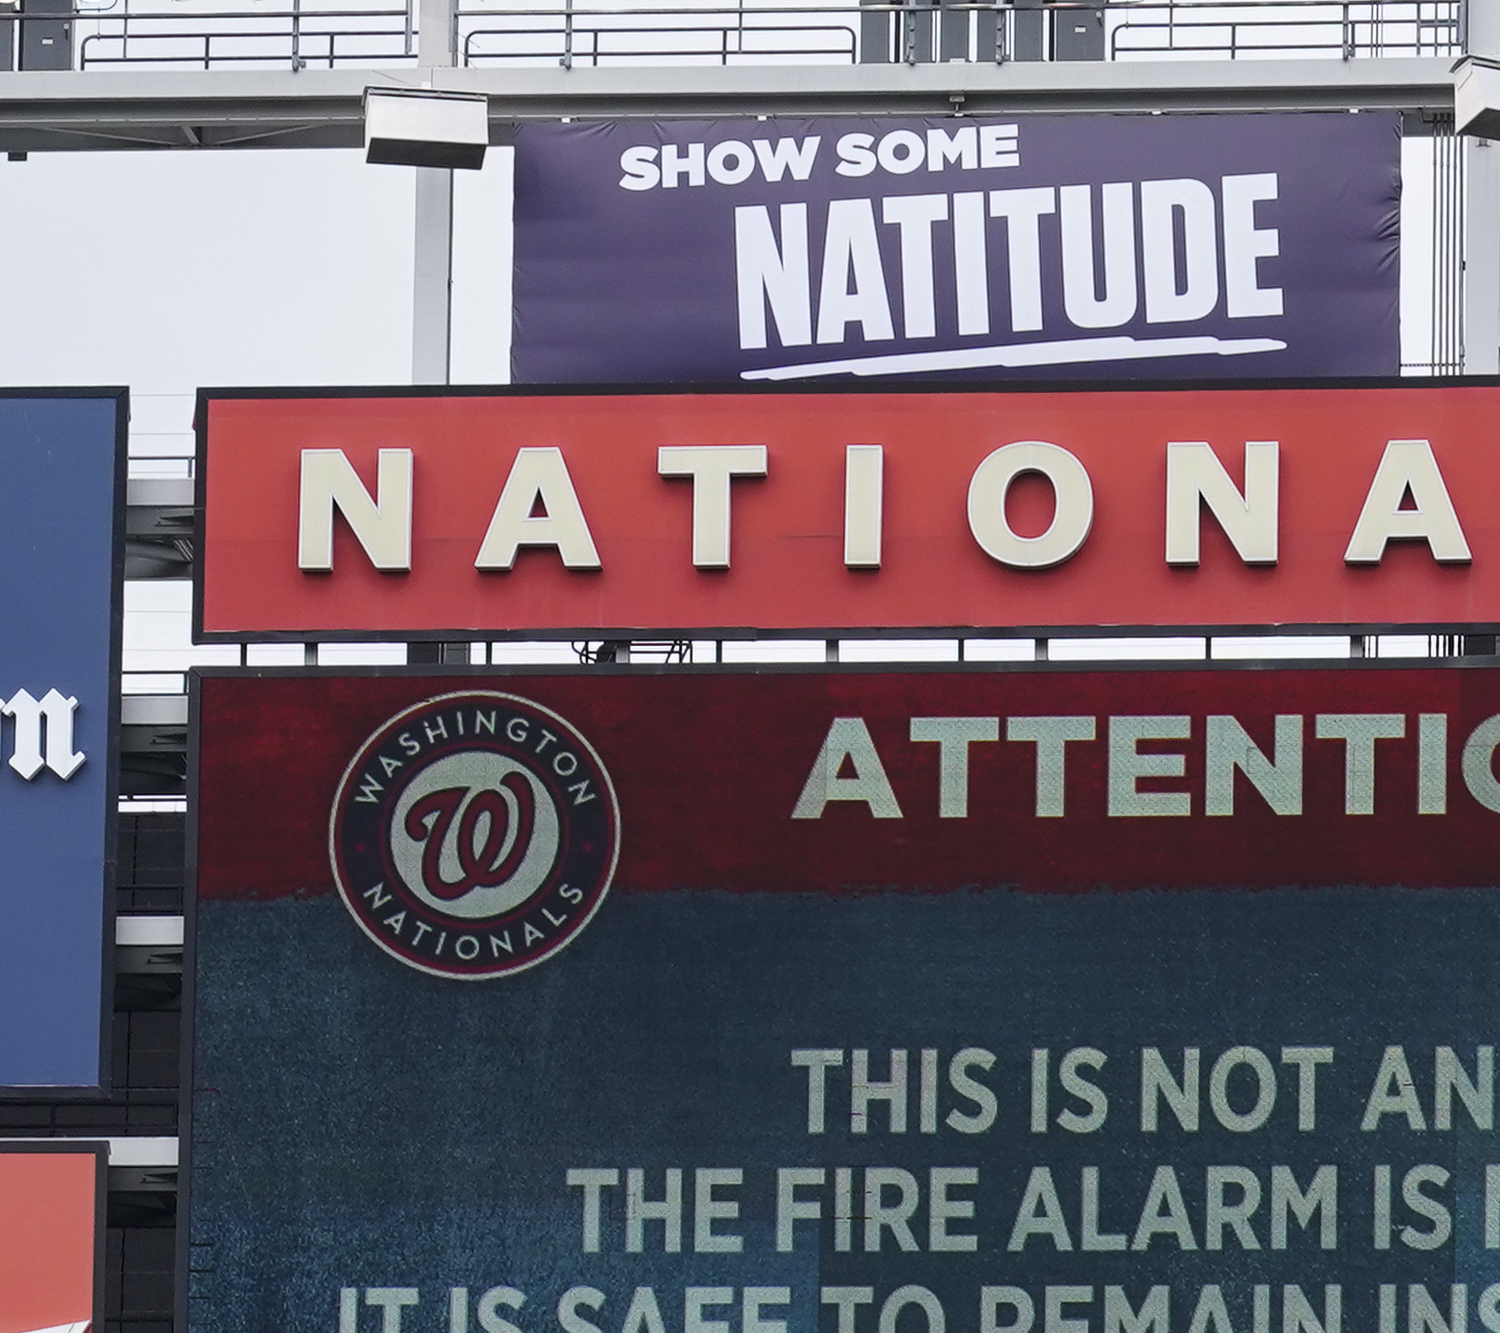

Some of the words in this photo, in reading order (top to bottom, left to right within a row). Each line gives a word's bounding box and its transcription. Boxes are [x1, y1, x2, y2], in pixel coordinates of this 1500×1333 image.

[618, 138, 816, 191] SHOW
[833, 122, 1021, 181] SOME
[735, 172, 1285, 353] NATITUDE
[352, 708, 599, 808] WASHINGTON
[360, 880, 587, 961] NATIONALS
[791, 1048, 998, 1135] THIS
[1030, 1047, 1107, 1134] IS
[1140, 1045, 1334, 1134] NOT
[1360, 1045, 1495, 1131] AN
[566, 1167, 744, 1253] THE
[775, 1167, 979, 1253] FIRE
[1006, 1165, 1338, 1252] ALARM
[1372, 1164, 1453, 1251] IS
